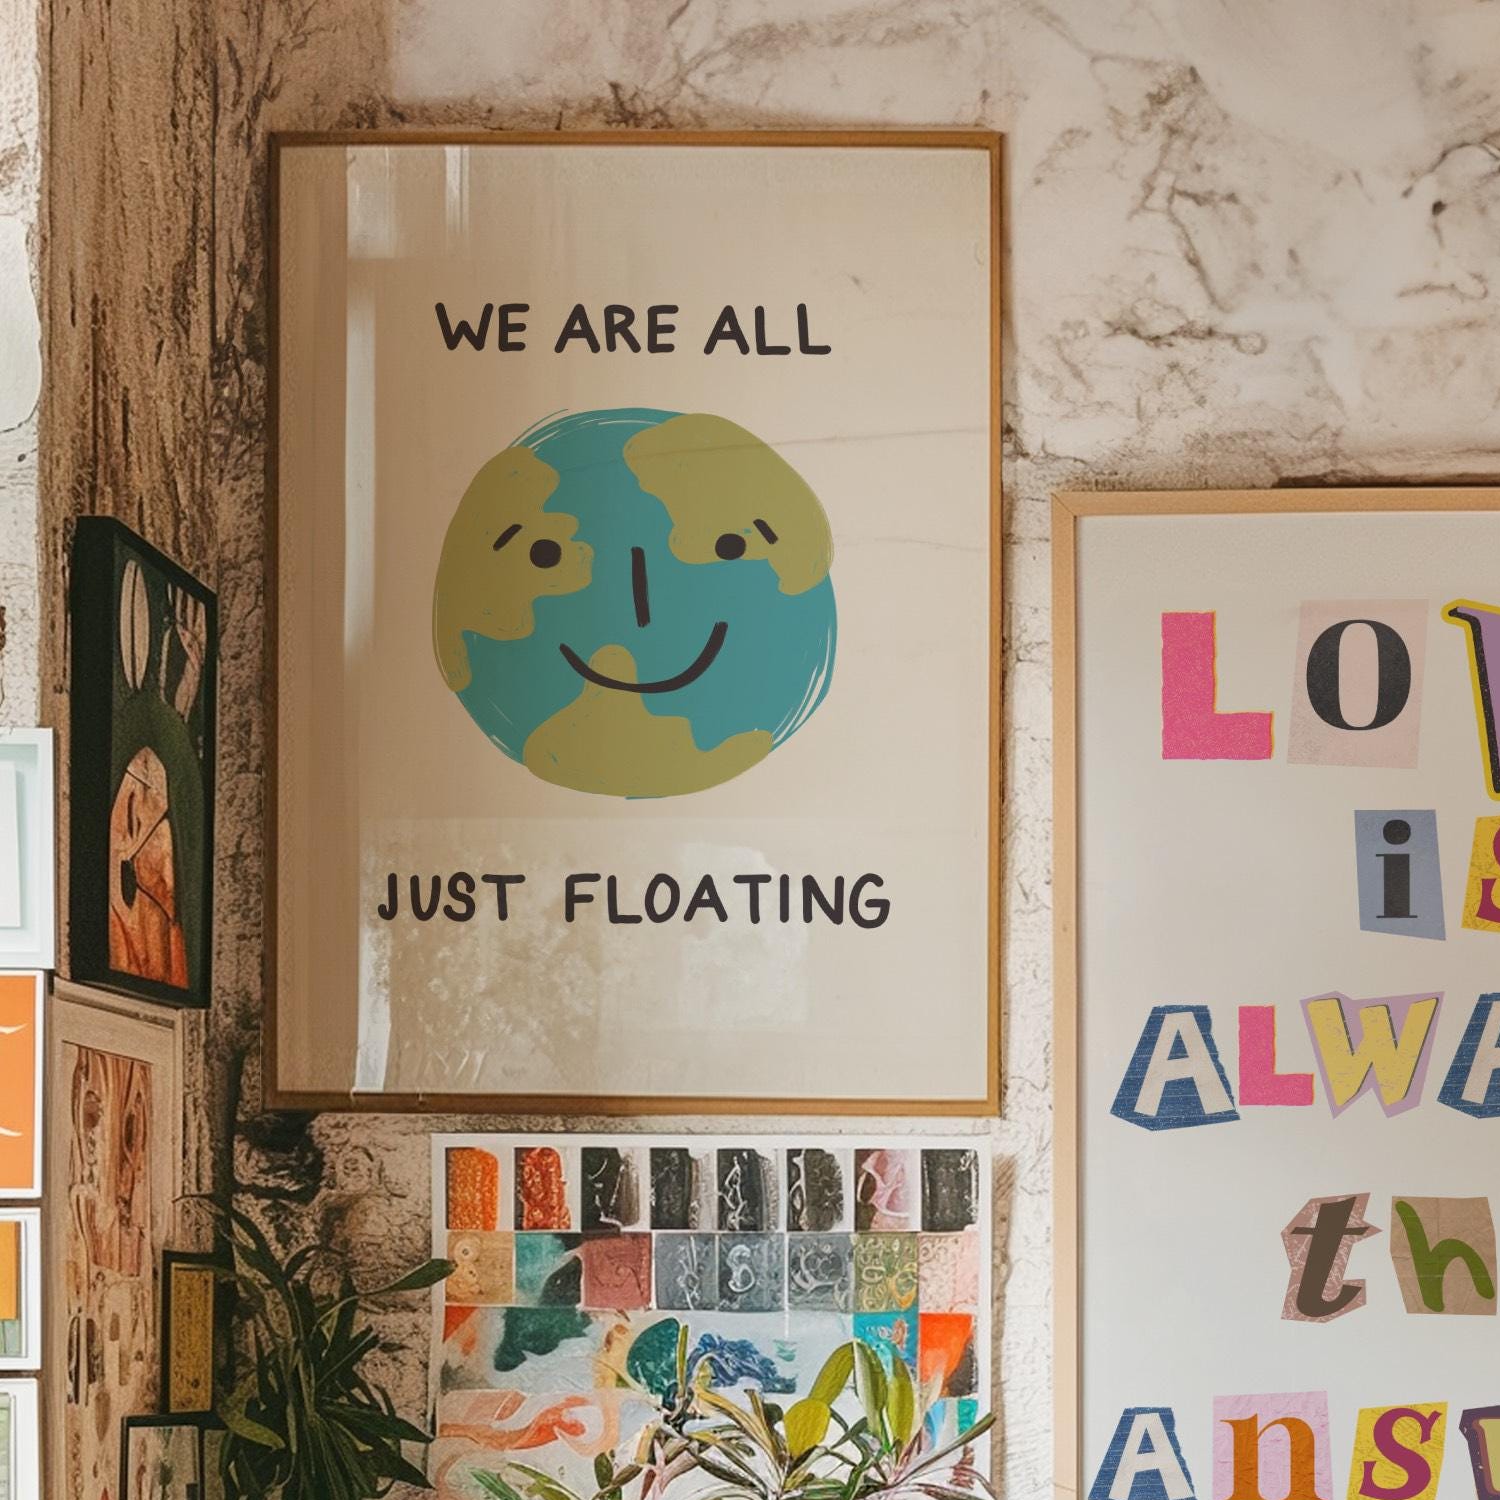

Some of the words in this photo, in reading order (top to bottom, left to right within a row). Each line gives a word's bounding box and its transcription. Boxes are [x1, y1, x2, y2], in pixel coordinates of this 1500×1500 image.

[434, 302, 530, 353] WE
[554, 303, 679, 354] ARE
[703, 303, 832, 356] ALL
[377, 871, 526, 923] JUST
[564, 873, 891, 929] FLOATING
